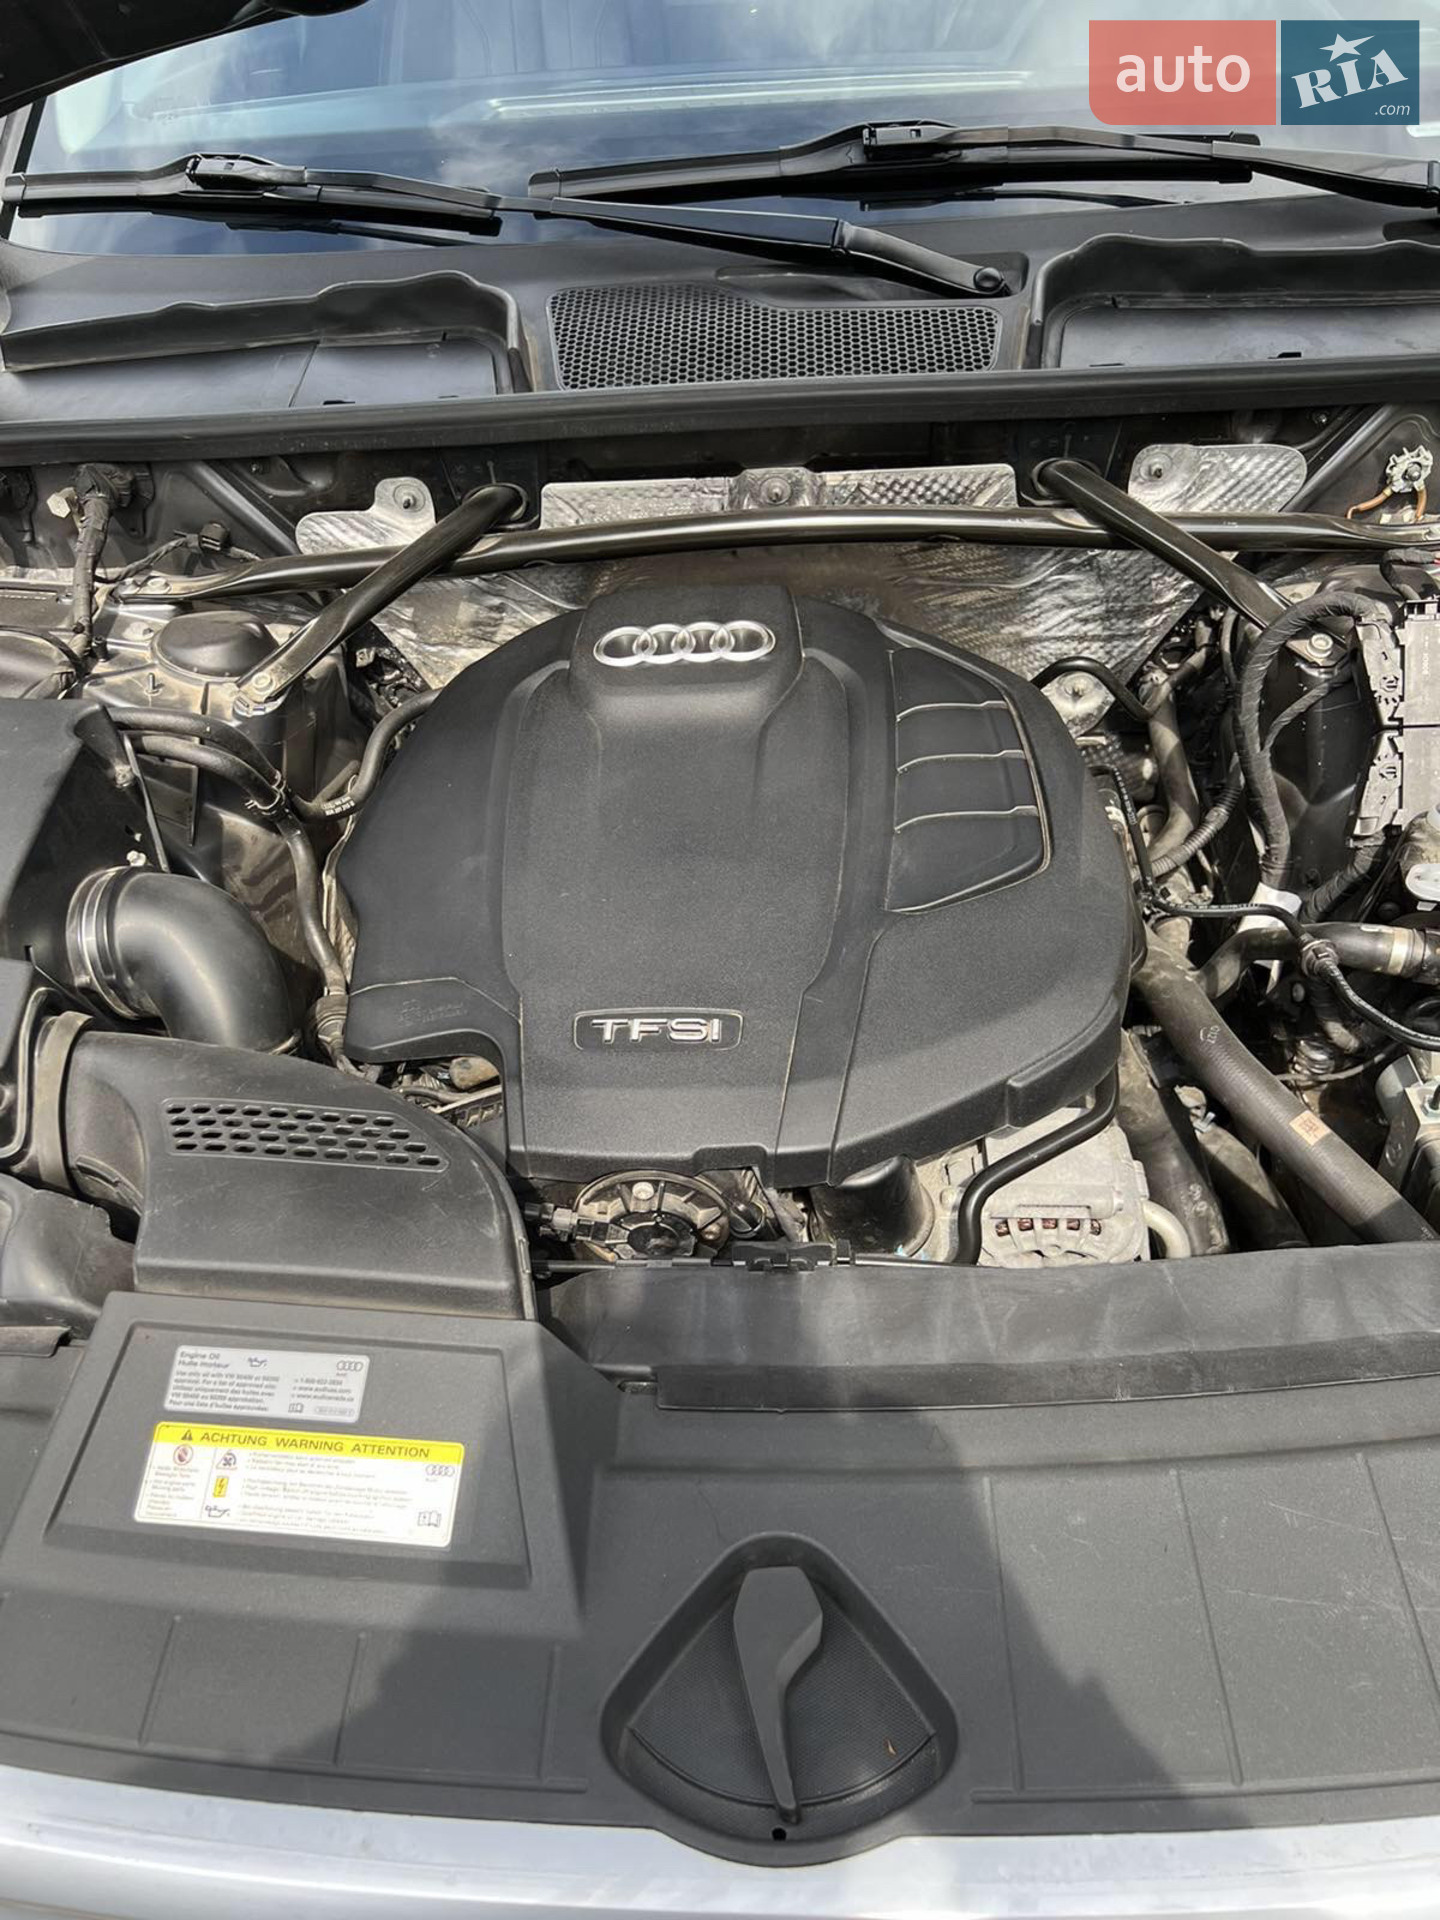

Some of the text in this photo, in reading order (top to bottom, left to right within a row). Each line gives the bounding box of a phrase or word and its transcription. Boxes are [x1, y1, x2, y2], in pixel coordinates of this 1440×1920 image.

[591, 1018, 721, 1044] TFSI
[177, 1359, 198, 1367] Huile
[180, 1351, 207, 1360] Engine
[199, 1431, 268, 1447] ACHTUNG
[275, 1437, 344, 1453] WARNING
[351, 1443, 430, 1459] ATTENTION
